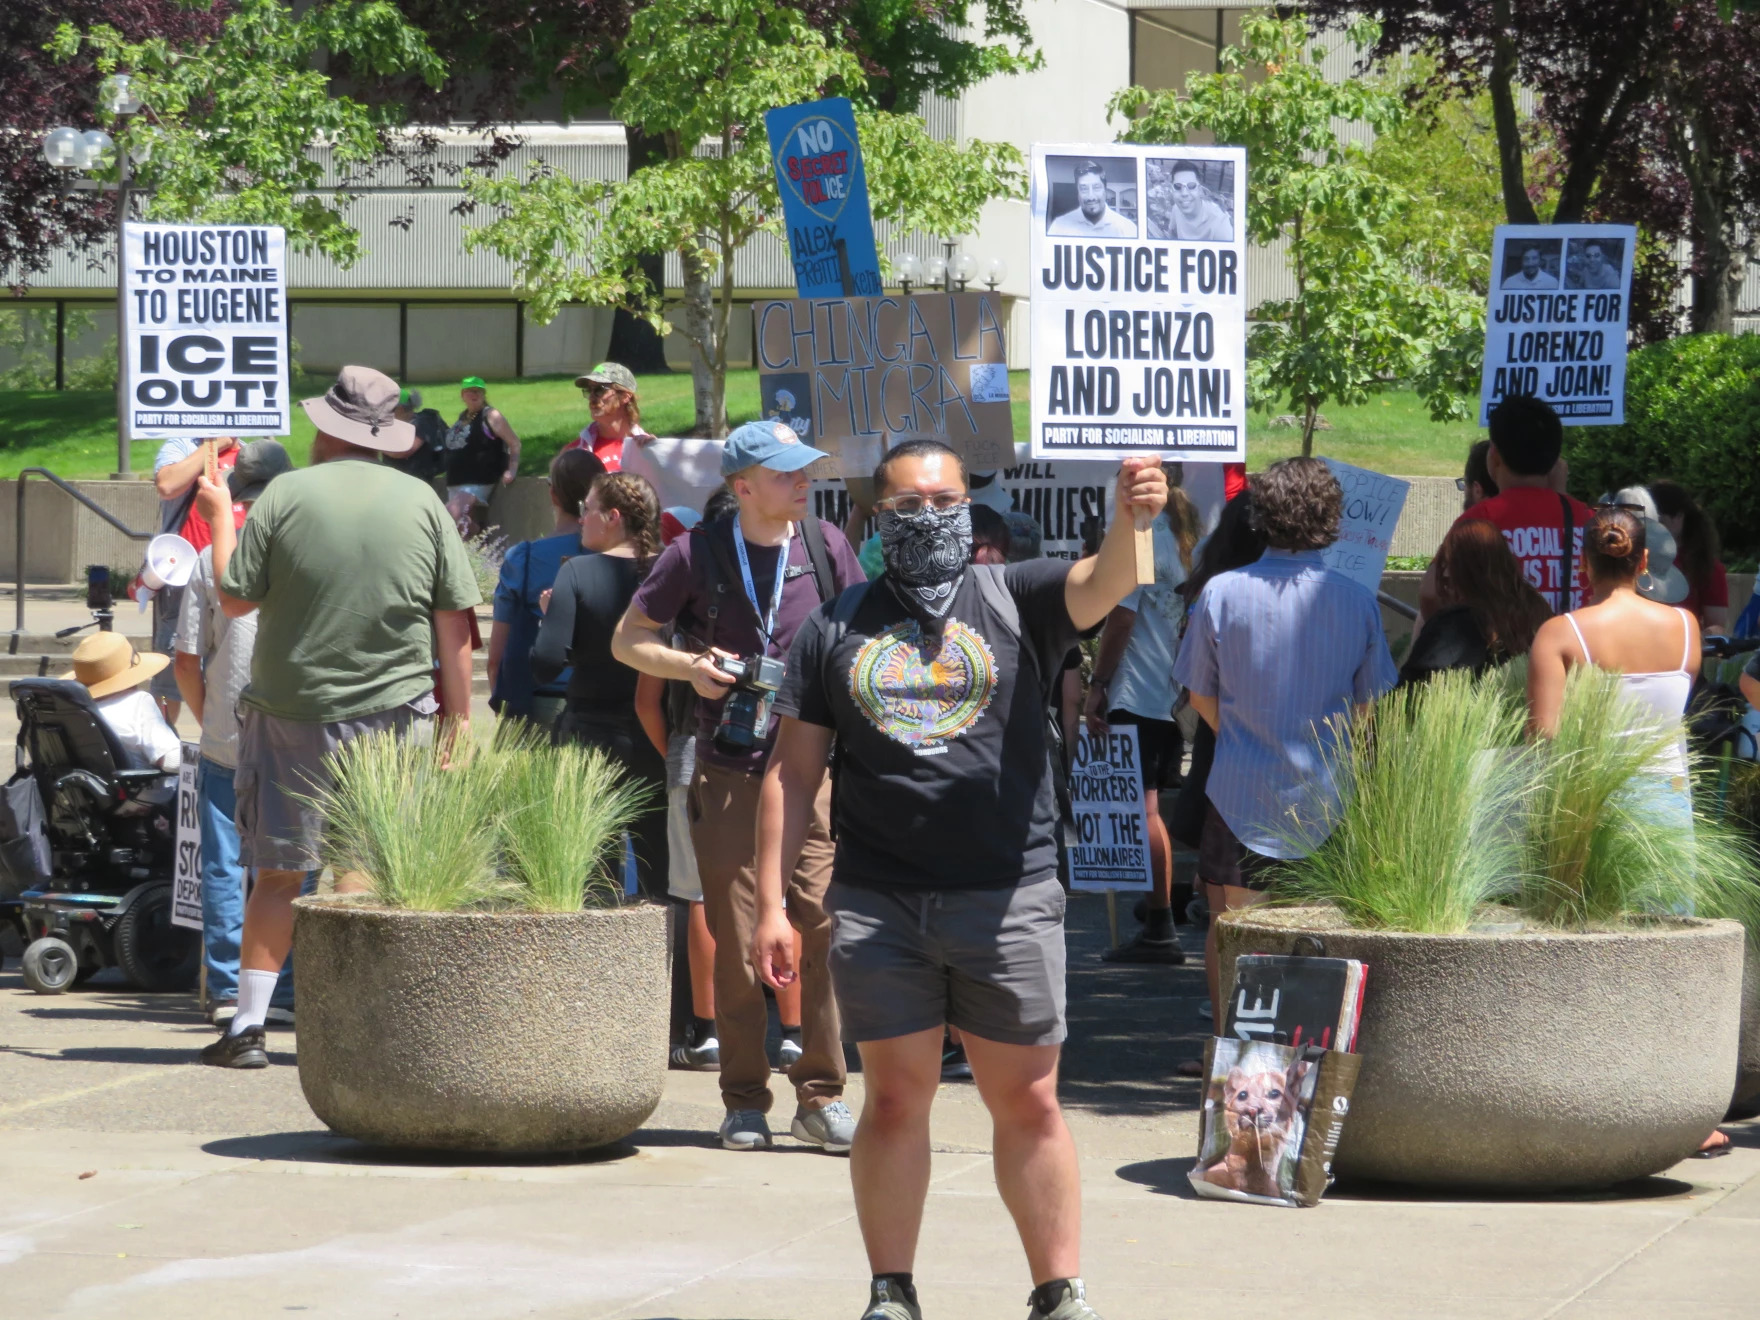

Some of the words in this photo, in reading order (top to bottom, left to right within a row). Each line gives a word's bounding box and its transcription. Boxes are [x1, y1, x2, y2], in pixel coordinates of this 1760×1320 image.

[798, 120, 833, 156] NO
[787, 151, 848, 181] SECRET
[802, 175, 845, 205] POLICE
[143, 230, 269, 266] HOUSTON
[135, 269, 177, 284] TO
[182, 268, 278, 283] MAINE
[1042, 244, 1169, 293] JUSTICE
[1179, 248, 1238, 295] FOR
[134, 289, 167, 324] TO
[178, 288, 280, 324] EUGENE
[1495, 294, 1578, 323] JUSTICE
[1583, 293, 1621, 322] FOR
[760, 297, 938, 370] CHINGA
[949, 295, 1006, 360] LA
[1064, 309, 1215, 362] LORENZO
[1506, 330, 1604, 363] LORENZO
[140, 335, 278, 375] ICE
[136, 379, 279, 408] OUT!
[1048, 365, 1120, 416] AND
[1132, 367, 1232, 419] JOAN!
[1492, 366, 1539, 399] AND
[1545, 365, 1612, 397] JOAN!
[815, 362, 980, 437] MIGRA
[1572, 402, 1611, 413] LIBERATION
[136, 413, 163, 425] PARTY
[164, 413, 180, 425] FOR
[181, 413, 225, 426] SOCIALISM
[226, 414, 234, 425] &
[234, 414, 280, 426] LIBERATION
[1044, 426, 1079, 444] PARTY
[1081, 427, 1103, 444] FOR
[1104, 427, 1164, 446] SOCIALISM
[1166, 429, 1175, 445] &
[1176, 429, 1236, 447] LIBERATION
[1003, 463, 1056, 479] WILL
[1331, 549, 1367, 571] ICE
[1075, 733, 1135, 769] OWER
[1088, 765, 1098, 776] TO
[1098, 764, 1110, 776] THE
[1071, 775, 1139, 802] WORKERS
[1108, 813, 1143, 845] THE
[1073, 848, 1145, 867] BILLIONAIRES!
